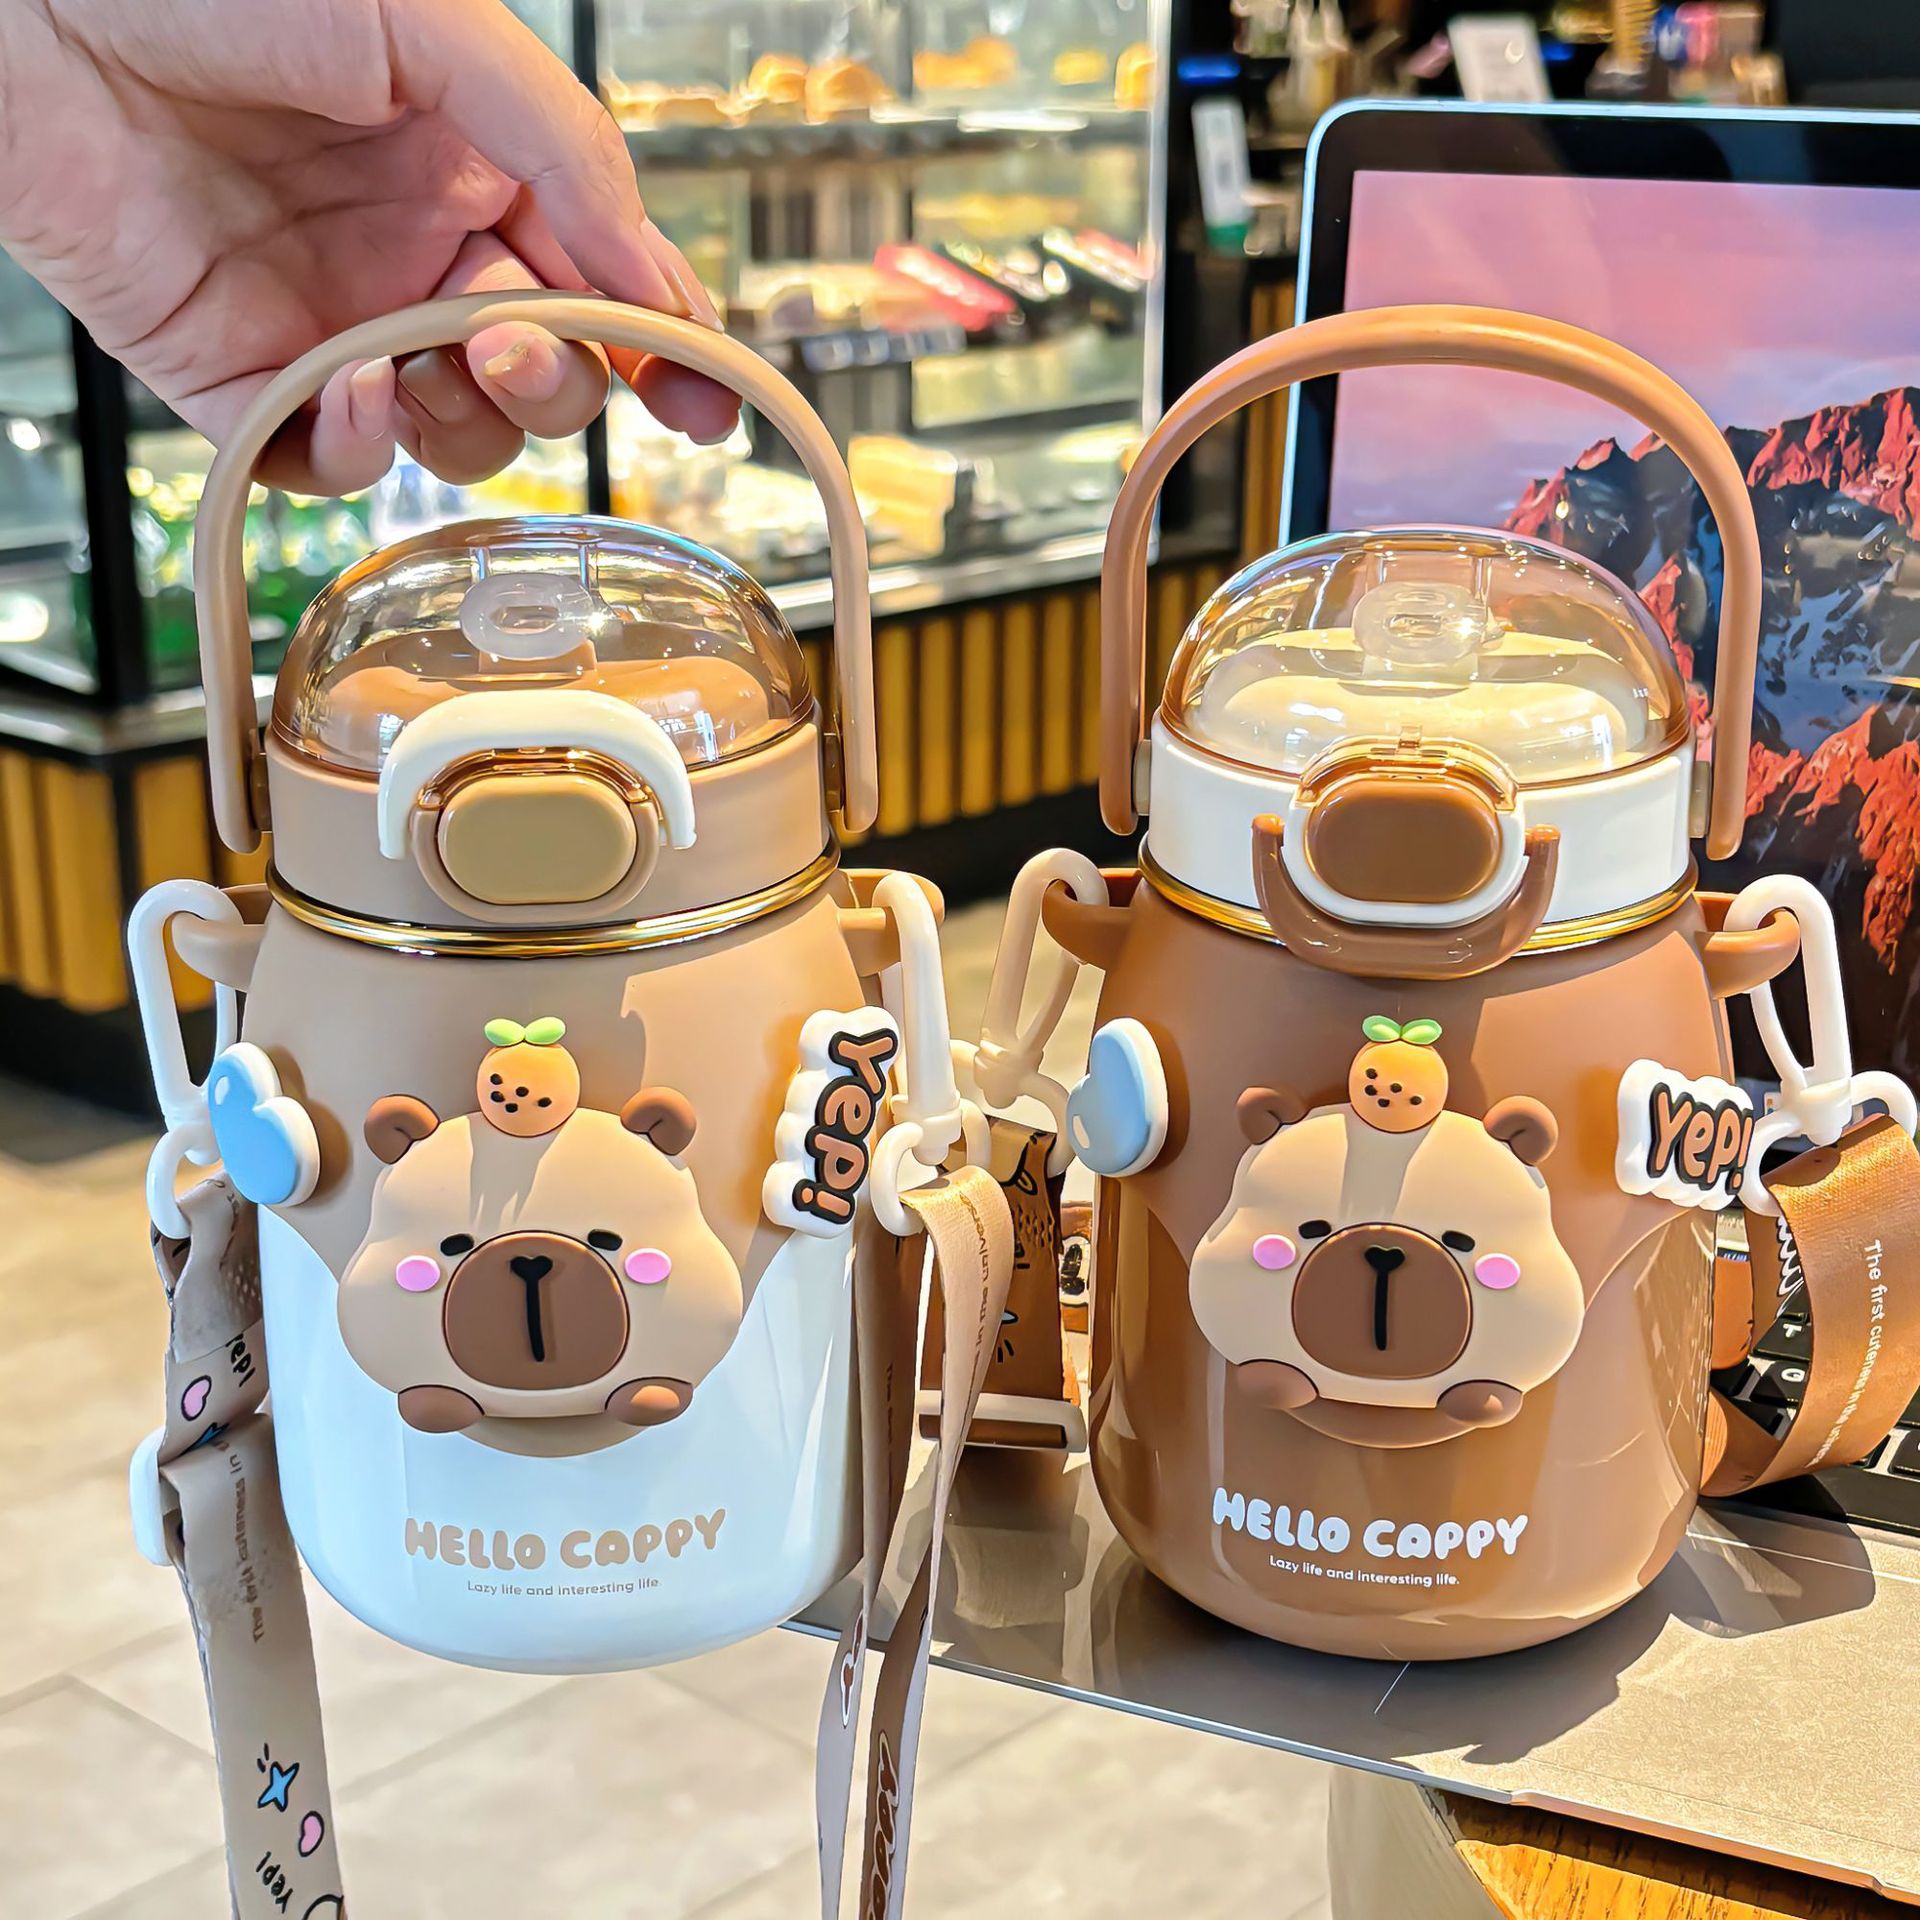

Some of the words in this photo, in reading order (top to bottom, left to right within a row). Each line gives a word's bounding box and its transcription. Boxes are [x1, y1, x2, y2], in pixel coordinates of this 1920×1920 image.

[793, 1028, 899, 1225] Yep!
[1646, 1082, 1754, 1196] Yep!
[1864, 1239, 1883, 1280] The
[1870, 1283, 1888, 1323] first
[1854, 1325, 1882, 1390] cuteness
[404, 1516, 547, 1571] HELLO
[559, 1507, 727, 1569] CAPPY
[1211, 1486, 1351, 1554] HELLO
[1362, 1514, 1530, 1560] CAPPY
[467, 1580, 498, 1595] Lazy
[501, 1583, 523, 1596] life
[526, 1585, 554, 1596] and
[558, 1581, 634, 1596] interesting
[1269, 1554, 1299, 1574] Lazy
[1302, 1562, 1323, 1577] life
[1326, 1569, 1354, 1581] and
[1357, 1570, 1433, 1588] interesting
[1436, 1573, 1460, 1586] life.
